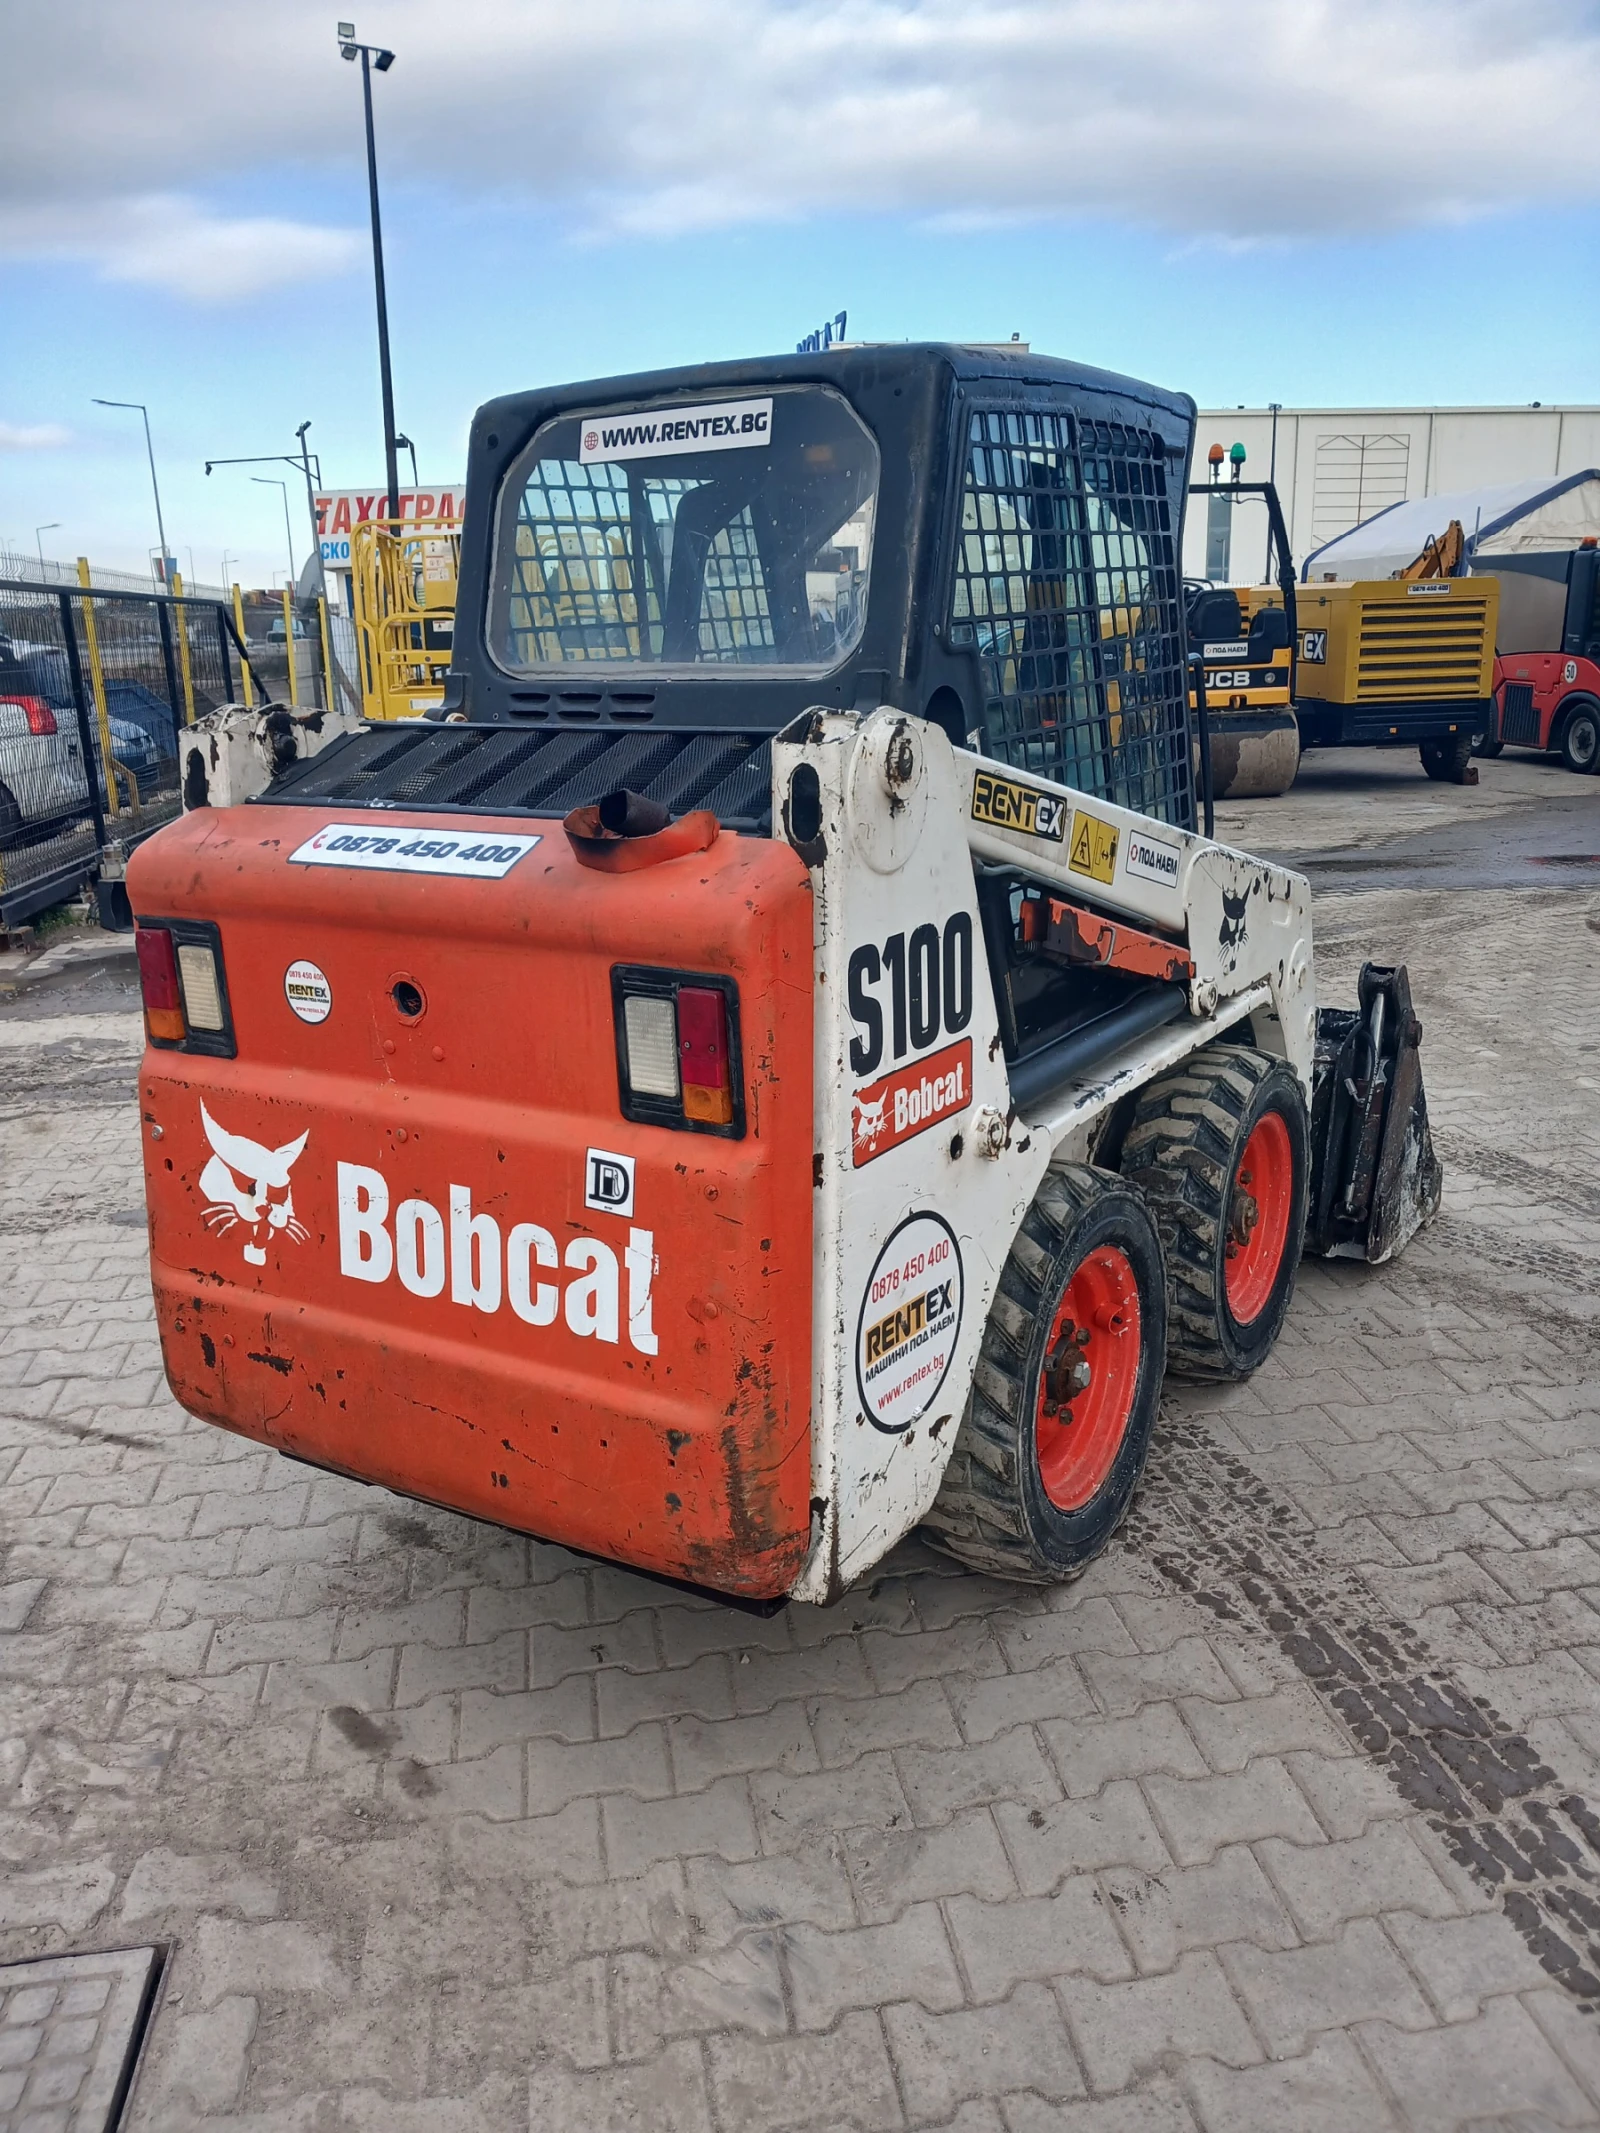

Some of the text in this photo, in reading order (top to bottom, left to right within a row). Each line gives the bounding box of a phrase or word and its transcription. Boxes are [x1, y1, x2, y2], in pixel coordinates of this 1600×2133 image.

[602, 412, 768, 448] WWW.RENTEX.BG
[1204, 671, 1250, 688] JCB
[1566, 664, 1575, 679] 50
[975, 778, 1064, 837] RENTEX
[326, 835, 522, 863] 0878 450 400
[1138, 846, 1178, 876] ПОД НАЕМ
[288, 984, 327, 998] RENTEX
[848, 911, 973, 1078] S100
[894, 1061, 964, 1134] Bobcat
[588, 1156, 630, 1206] D
[337, 1160, 659, 1356] Bobcat
[871, 1239, 949, 1304] 0878 450 400
[865, 1311, 955, 1384] МАШИНИ ПОД НАЕМ
[867, 1278, 953, 1363] RENTEX
[877, 1353, 945, 1411] www.rentex.bg
